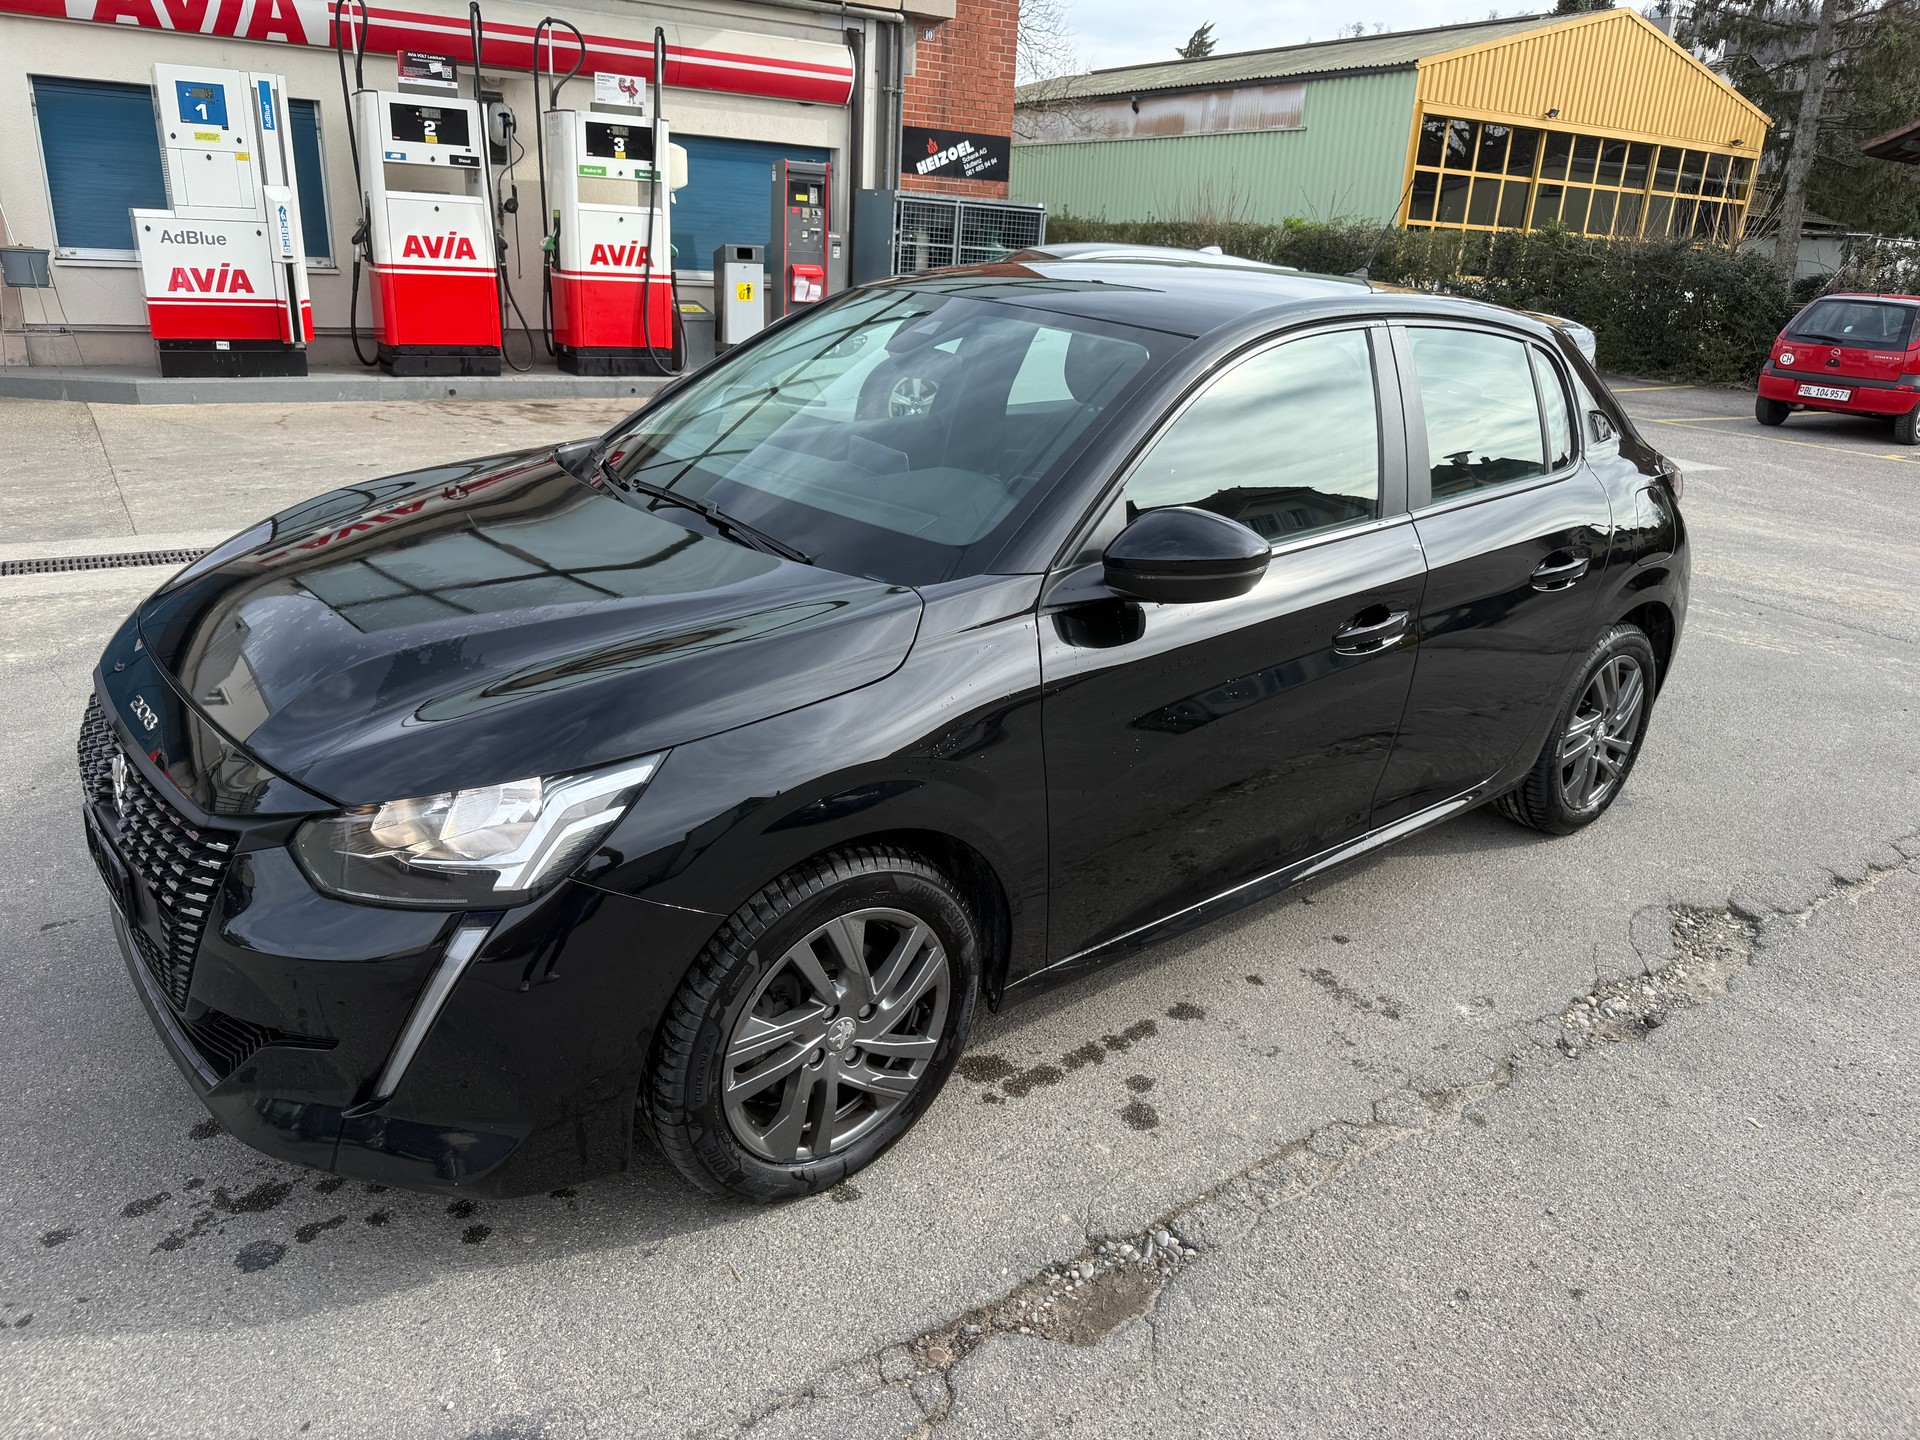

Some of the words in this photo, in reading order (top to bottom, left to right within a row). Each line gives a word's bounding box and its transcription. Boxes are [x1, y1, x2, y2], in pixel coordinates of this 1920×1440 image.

[925, 30, 933, 40] 10
[195, 103, 208, 120] 1
[424, 120, 437, 136] 2
[613, 137, 625, 152] 3
[979, 147, 988, 156] AG
[915, 140, 975, 175] HEIZOEL
[160, 229, 227, 247] AdBlue
[402, 231, 477, 261] AVIA
[590, 240, 655, 267] AVIA
[168, 263, 255, 294] AVIA
[1781, 354, 1793, 364] CH
[129, 694, 159, 732] 208
